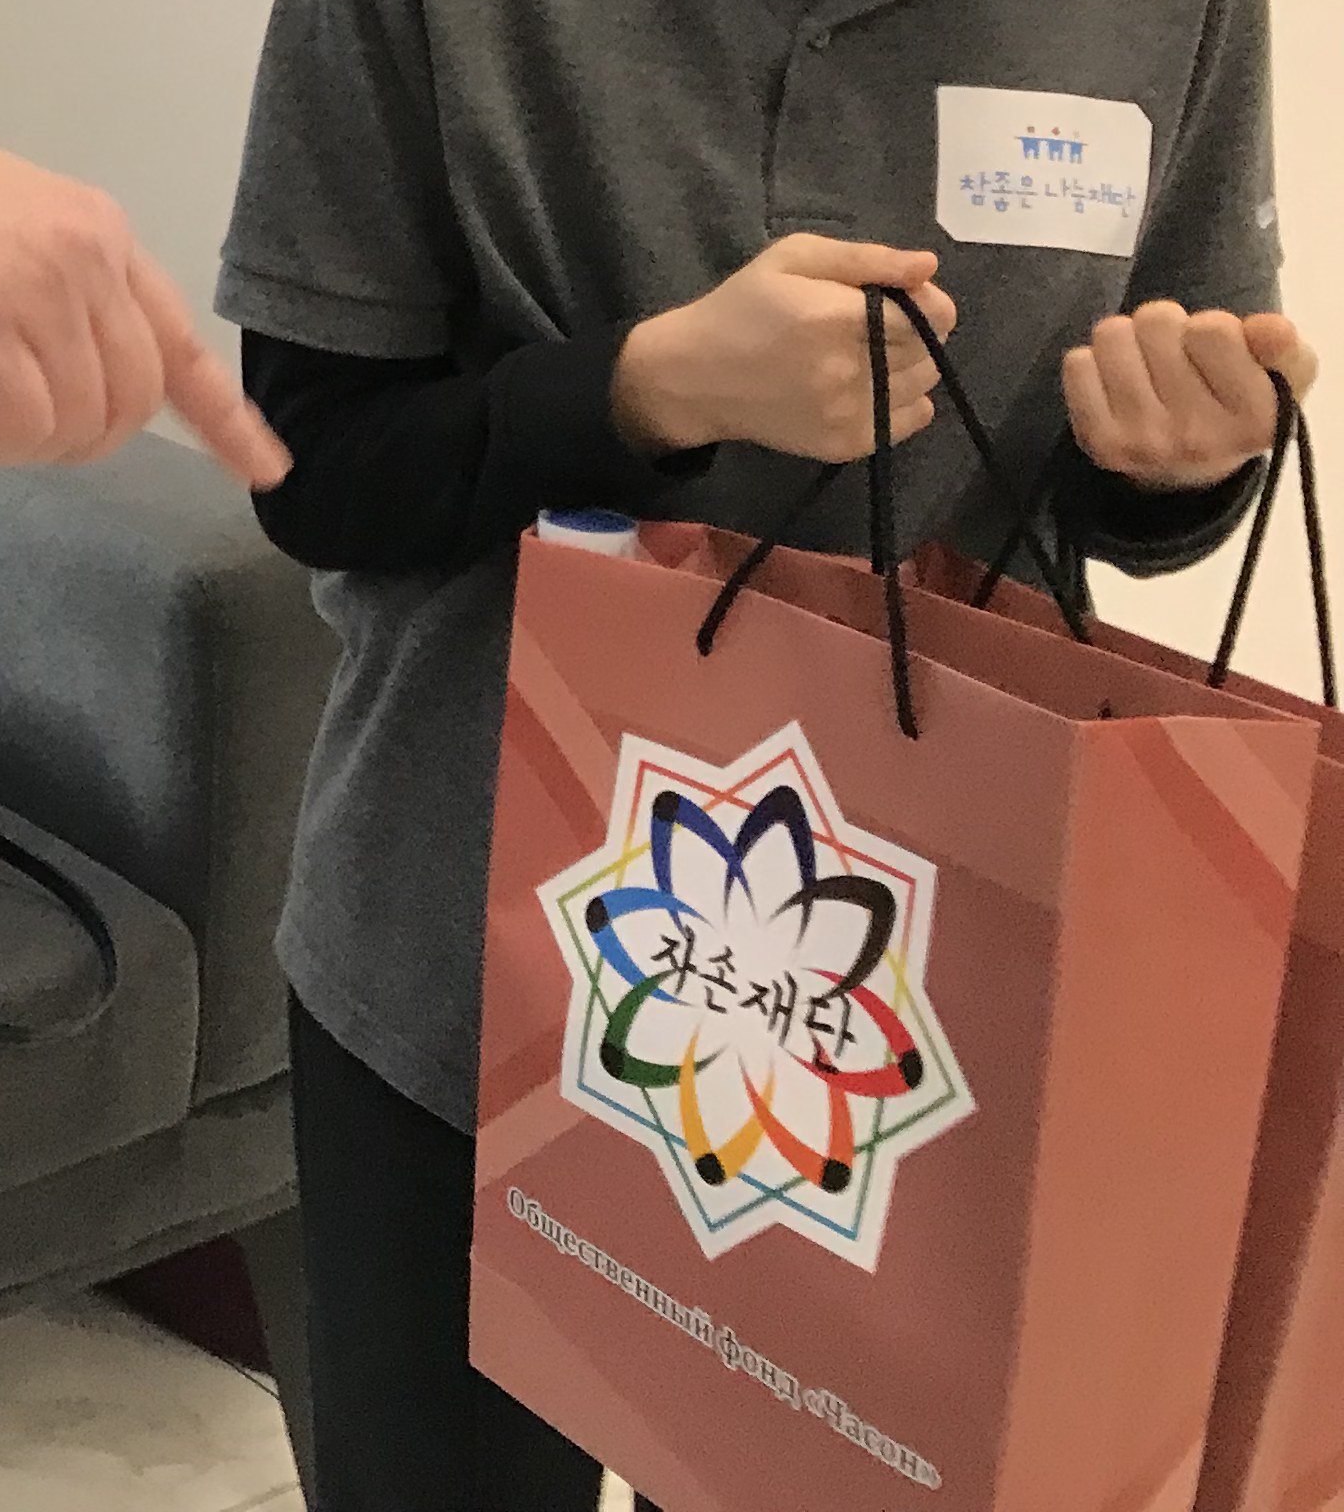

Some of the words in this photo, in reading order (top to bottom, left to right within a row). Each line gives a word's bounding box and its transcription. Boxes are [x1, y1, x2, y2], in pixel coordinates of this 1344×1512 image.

[650, 924, 856, 1074] 자손재단
[508, 1188, 713, 1344] Общественный
[717, 1329, 798, 1405] фонд
[805, 1390, 941, 1486] «Часон»
